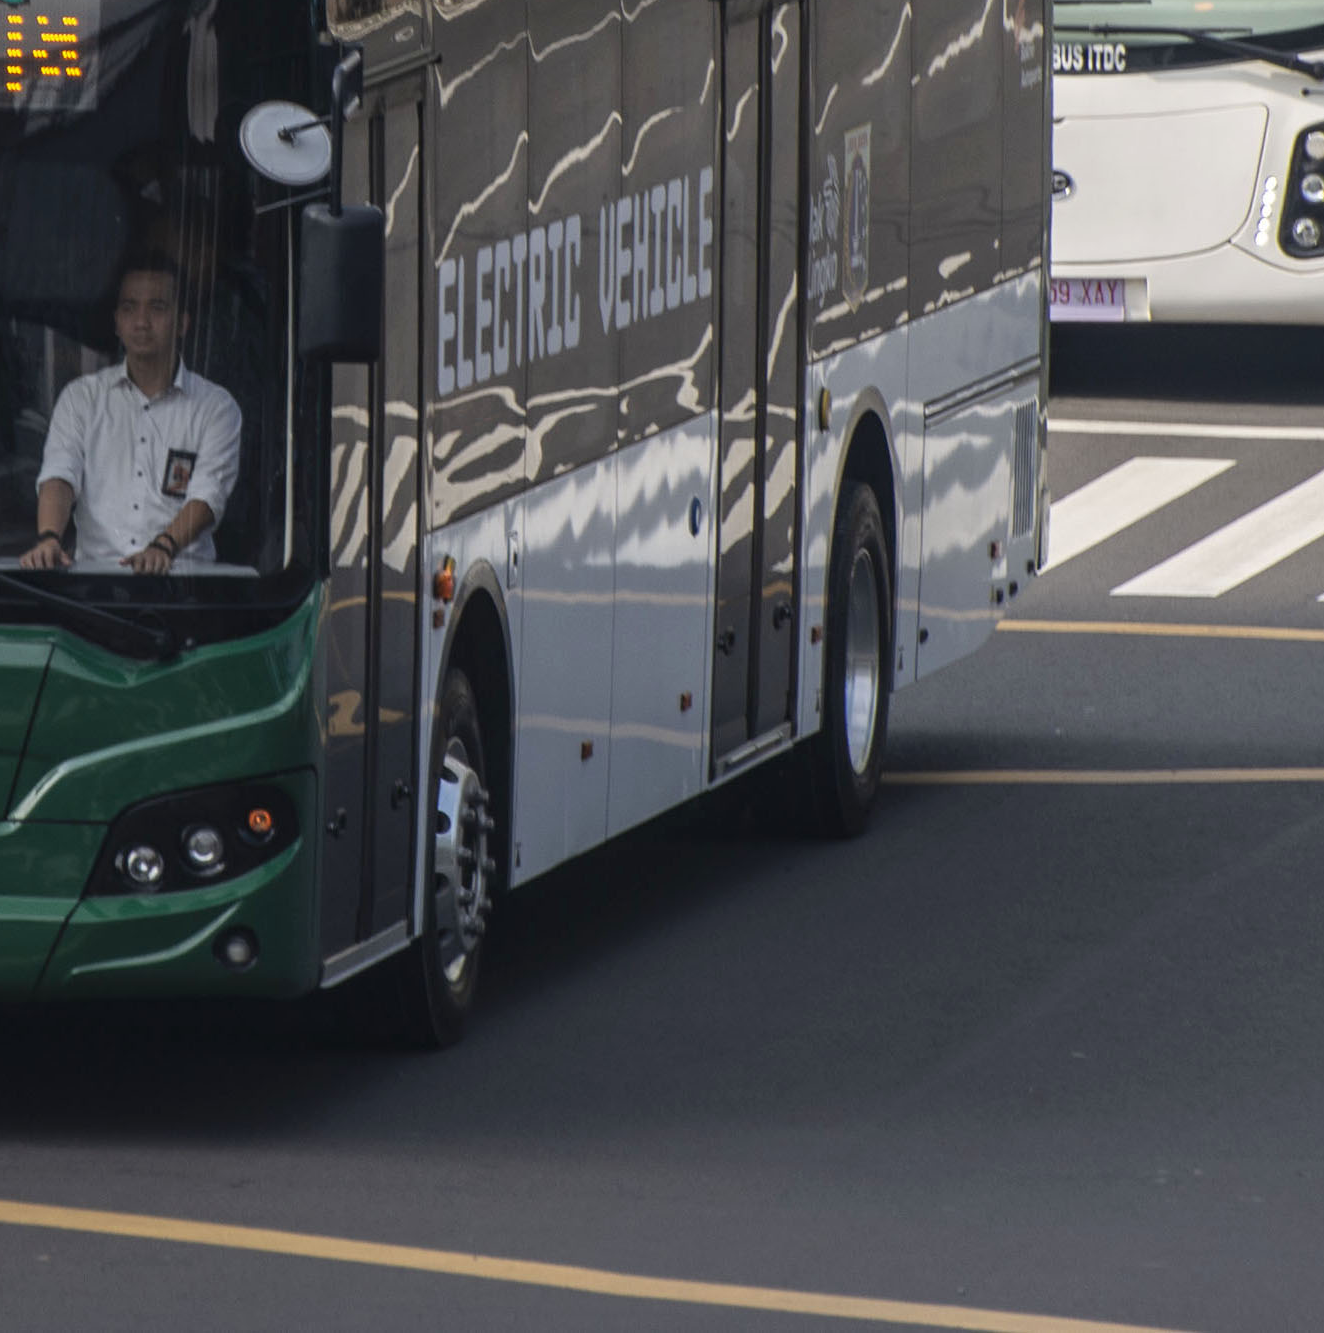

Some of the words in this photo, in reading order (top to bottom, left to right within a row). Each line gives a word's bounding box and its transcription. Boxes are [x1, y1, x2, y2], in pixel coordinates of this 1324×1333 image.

[1087, 42, 1126, 72] ITDC
[438, 213, 581, 397] ELECTRIC
[599, 165, 713, 336] VEHICLE
[1081, 279, 1118, 305] XAY
